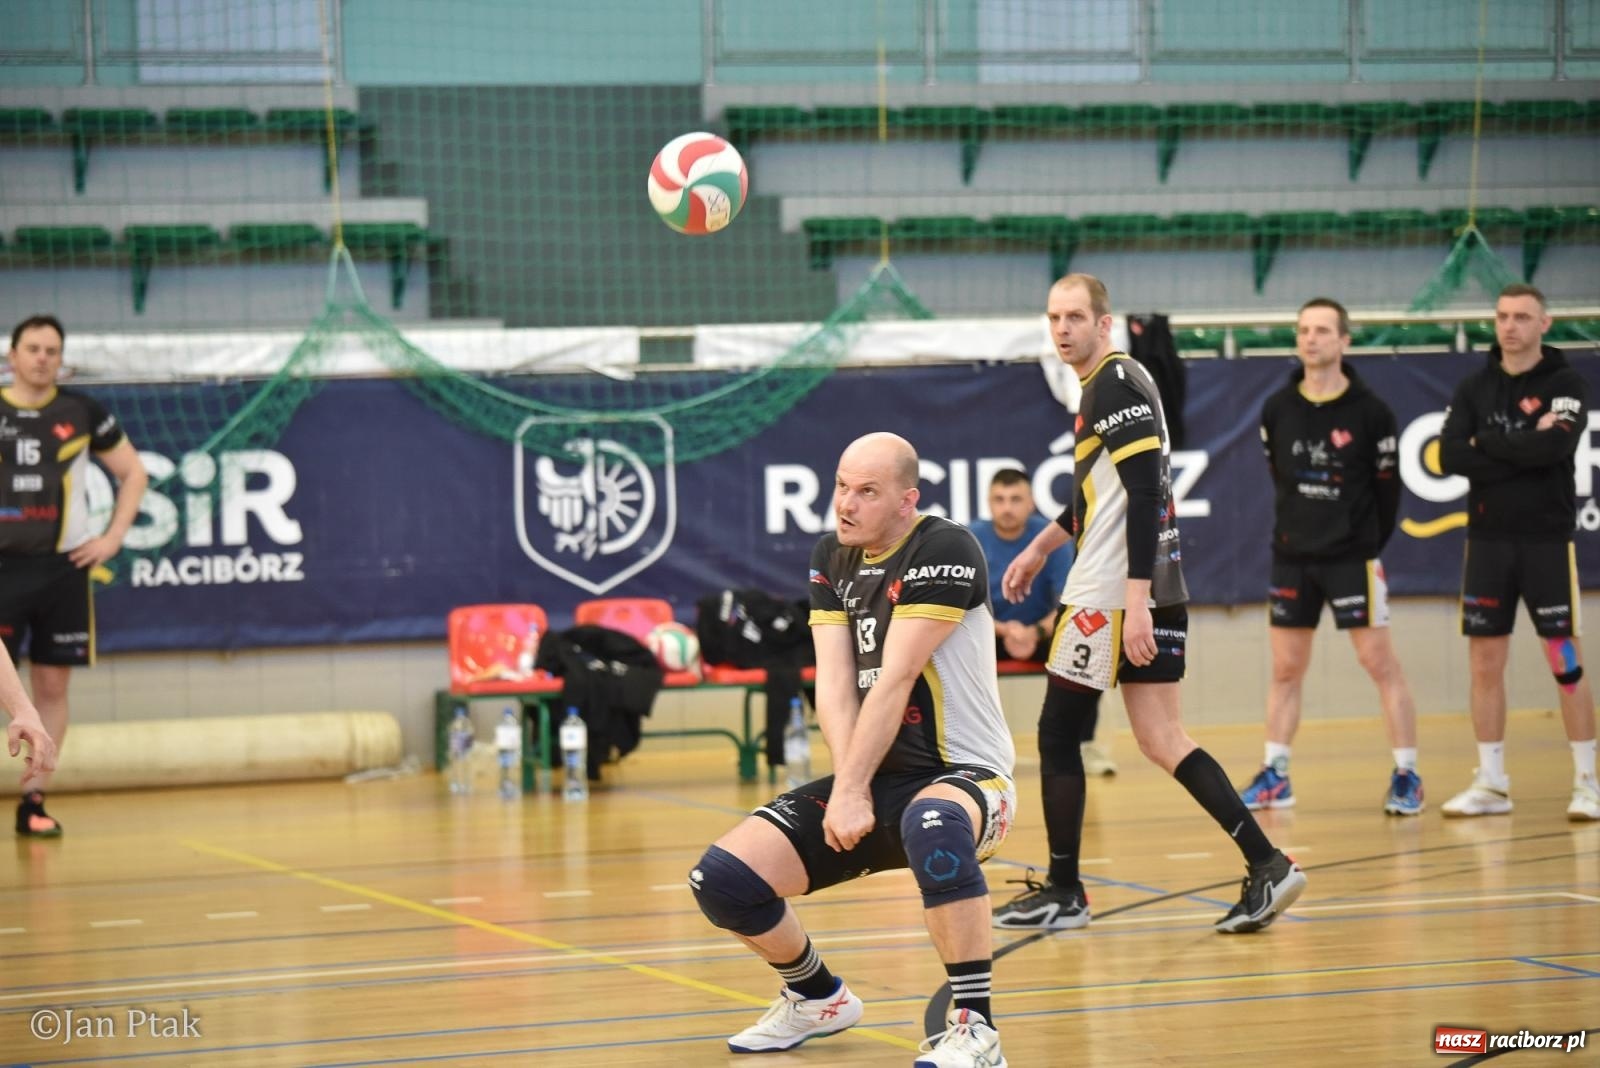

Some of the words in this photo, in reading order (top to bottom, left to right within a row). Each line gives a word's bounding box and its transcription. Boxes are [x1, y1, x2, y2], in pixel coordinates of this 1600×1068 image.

[1093, 403, 1152, 434] GRAVTON
[16, 438, 41, 466] 15
[131, 547, 305, 588] RACIBÓRZ
[856, 617, 877, 654] 13
[1072, 643, 1092, 670] 3
